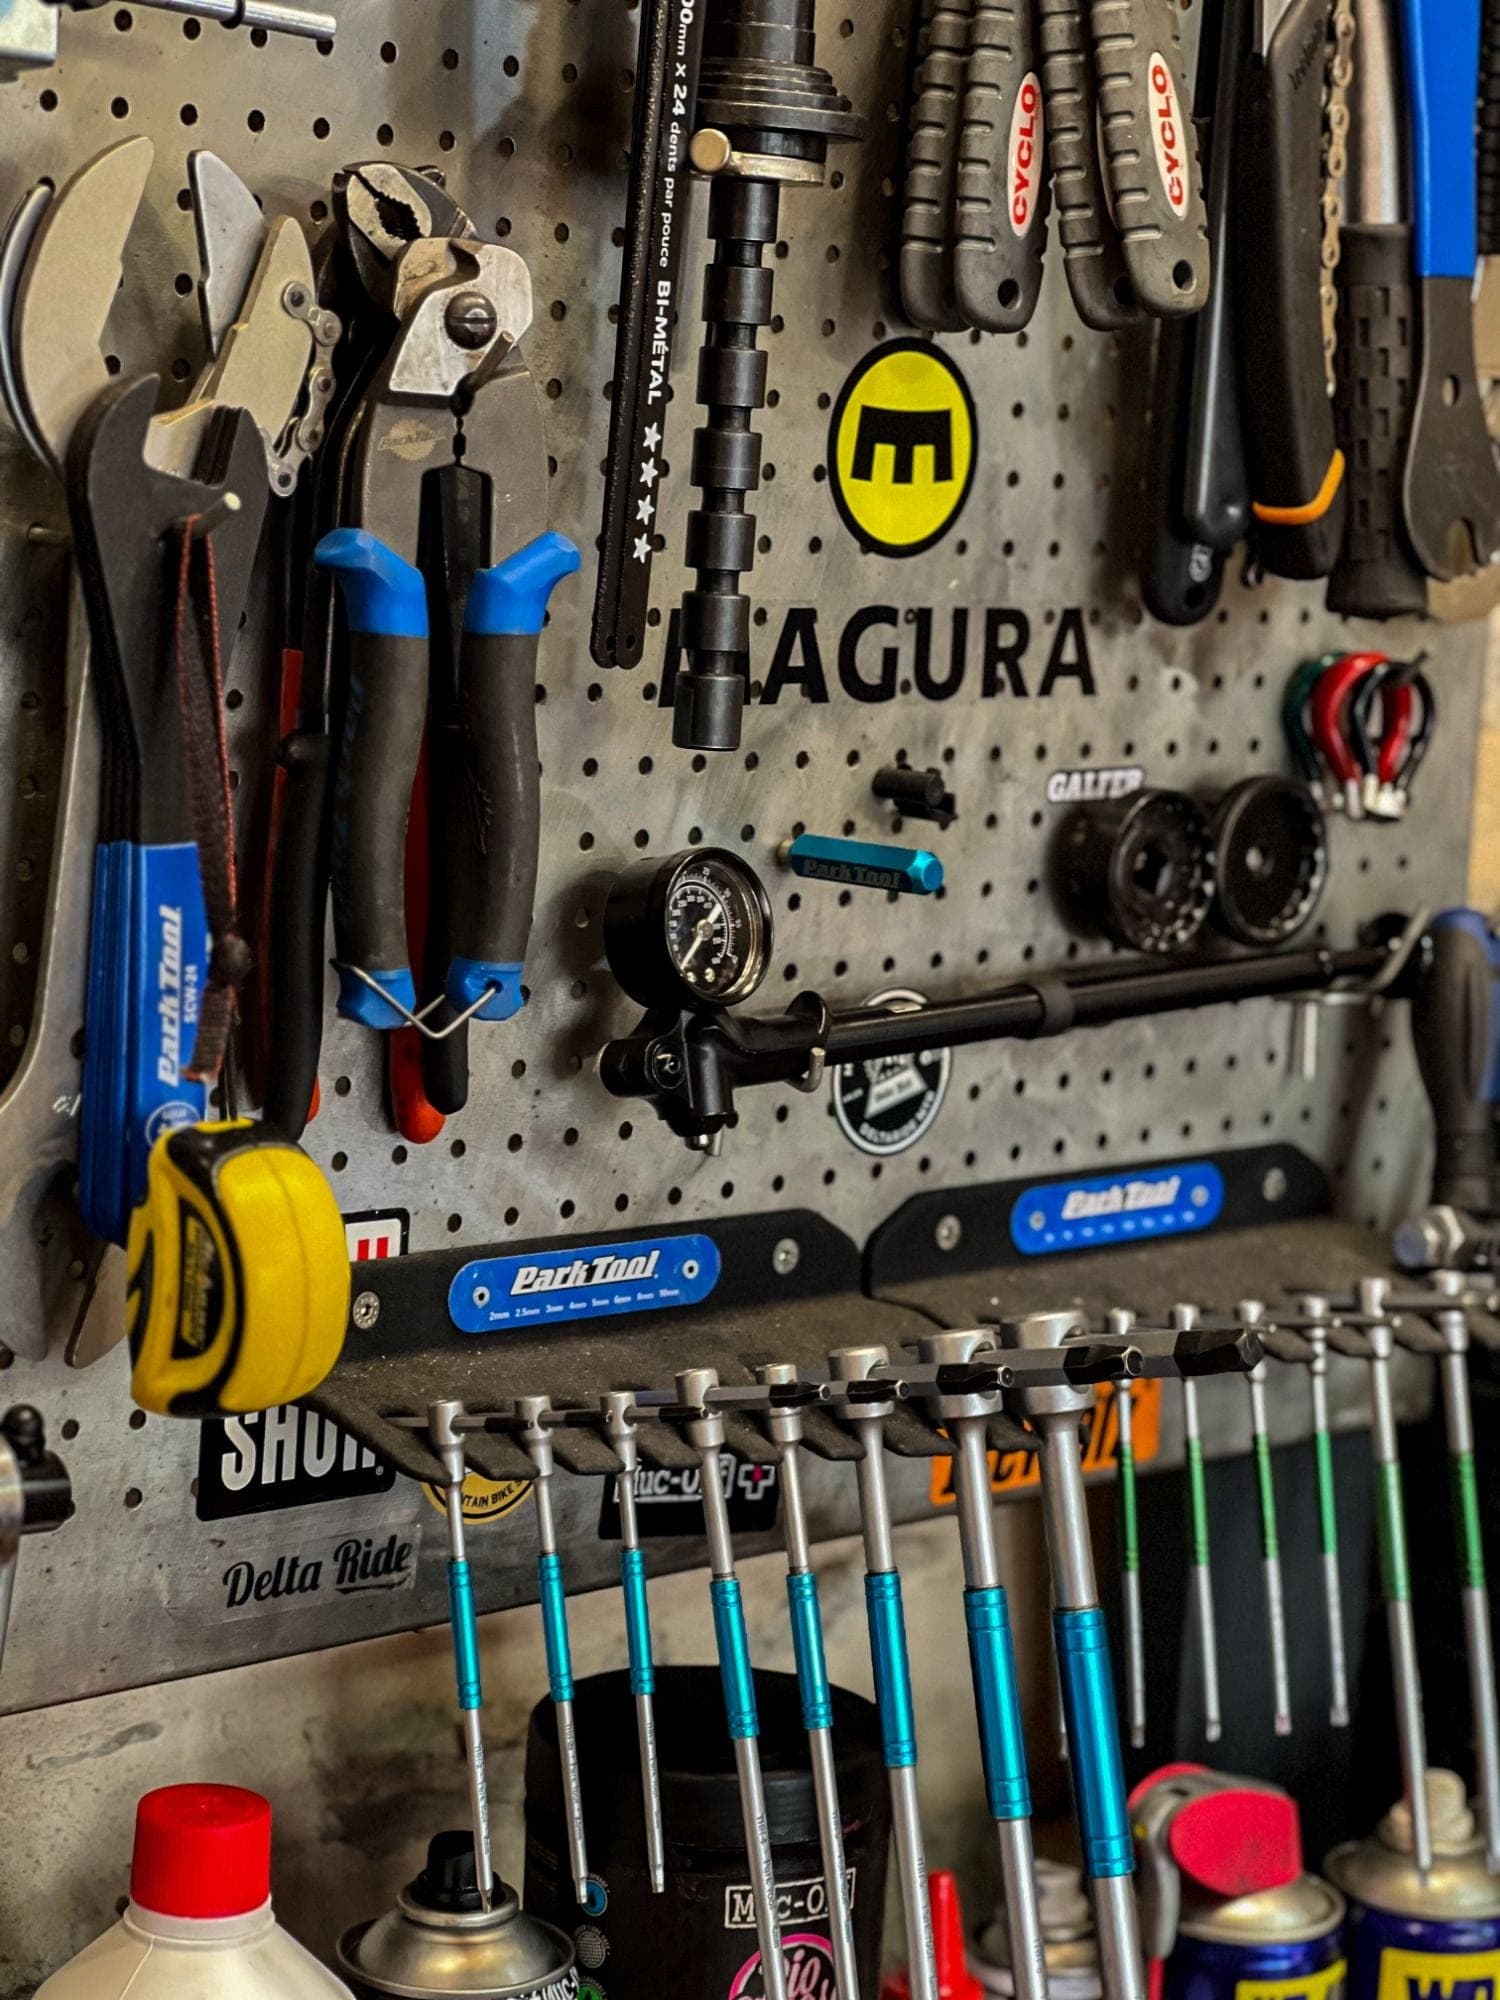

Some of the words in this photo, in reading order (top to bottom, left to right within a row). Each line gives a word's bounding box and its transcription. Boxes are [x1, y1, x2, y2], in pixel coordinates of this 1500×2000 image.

[672, 84, 688, 116] 24
[667, 122, 681, 172] dents
[1013, 83, 1038, 225] CYCLO
[1151, 64, 1184, 206] CYCLO
[663, 178, 675, 208] par
[659, 212, 673, 268] pouce
[647, 280, 672, 405] BI-MÉTAL
[489, 1310, 510, 1321] 2mm
[515, 1307, 540, 1318] 2.5mm
[491, 1483, 514, 1504] BIKE
[222, 1556, 323, 1608] Delta
[333, 1534, 413, 1586] Ride
